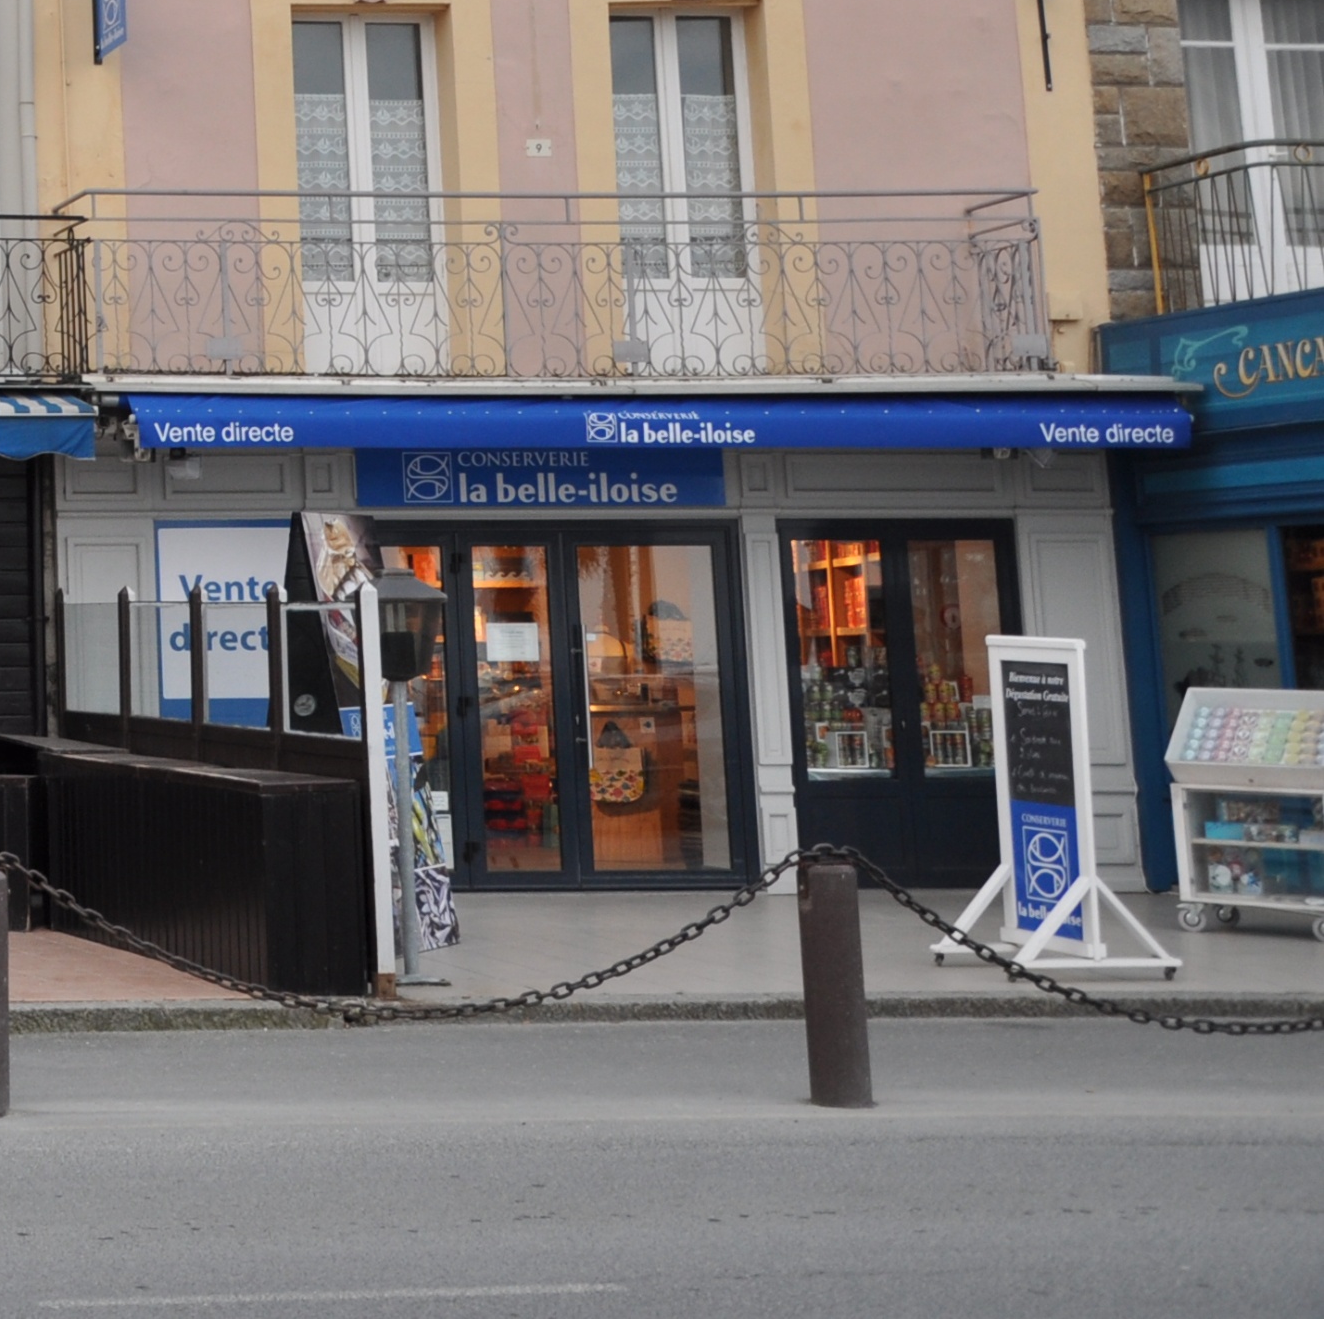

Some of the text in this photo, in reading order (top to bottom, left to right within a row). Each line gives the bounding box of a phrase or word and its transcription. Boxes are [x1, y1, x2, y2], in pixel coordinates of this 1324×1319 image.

[535, 143, 542, 153] 9
[154, 422, 294, 444] Vente directe
[620, 422, 756, 444] la belle-iloise
[1039, 423, 1175, 444] Vente directe
[457, 451, 590, 467] CONSERVERIE
[459, 471, 679, 504] la belle-iloise
[169, 623, 269, 652] drect
[1021, 813, 1067, 828] CONSERVERIE
[1018, 901, 1027, 917] la
